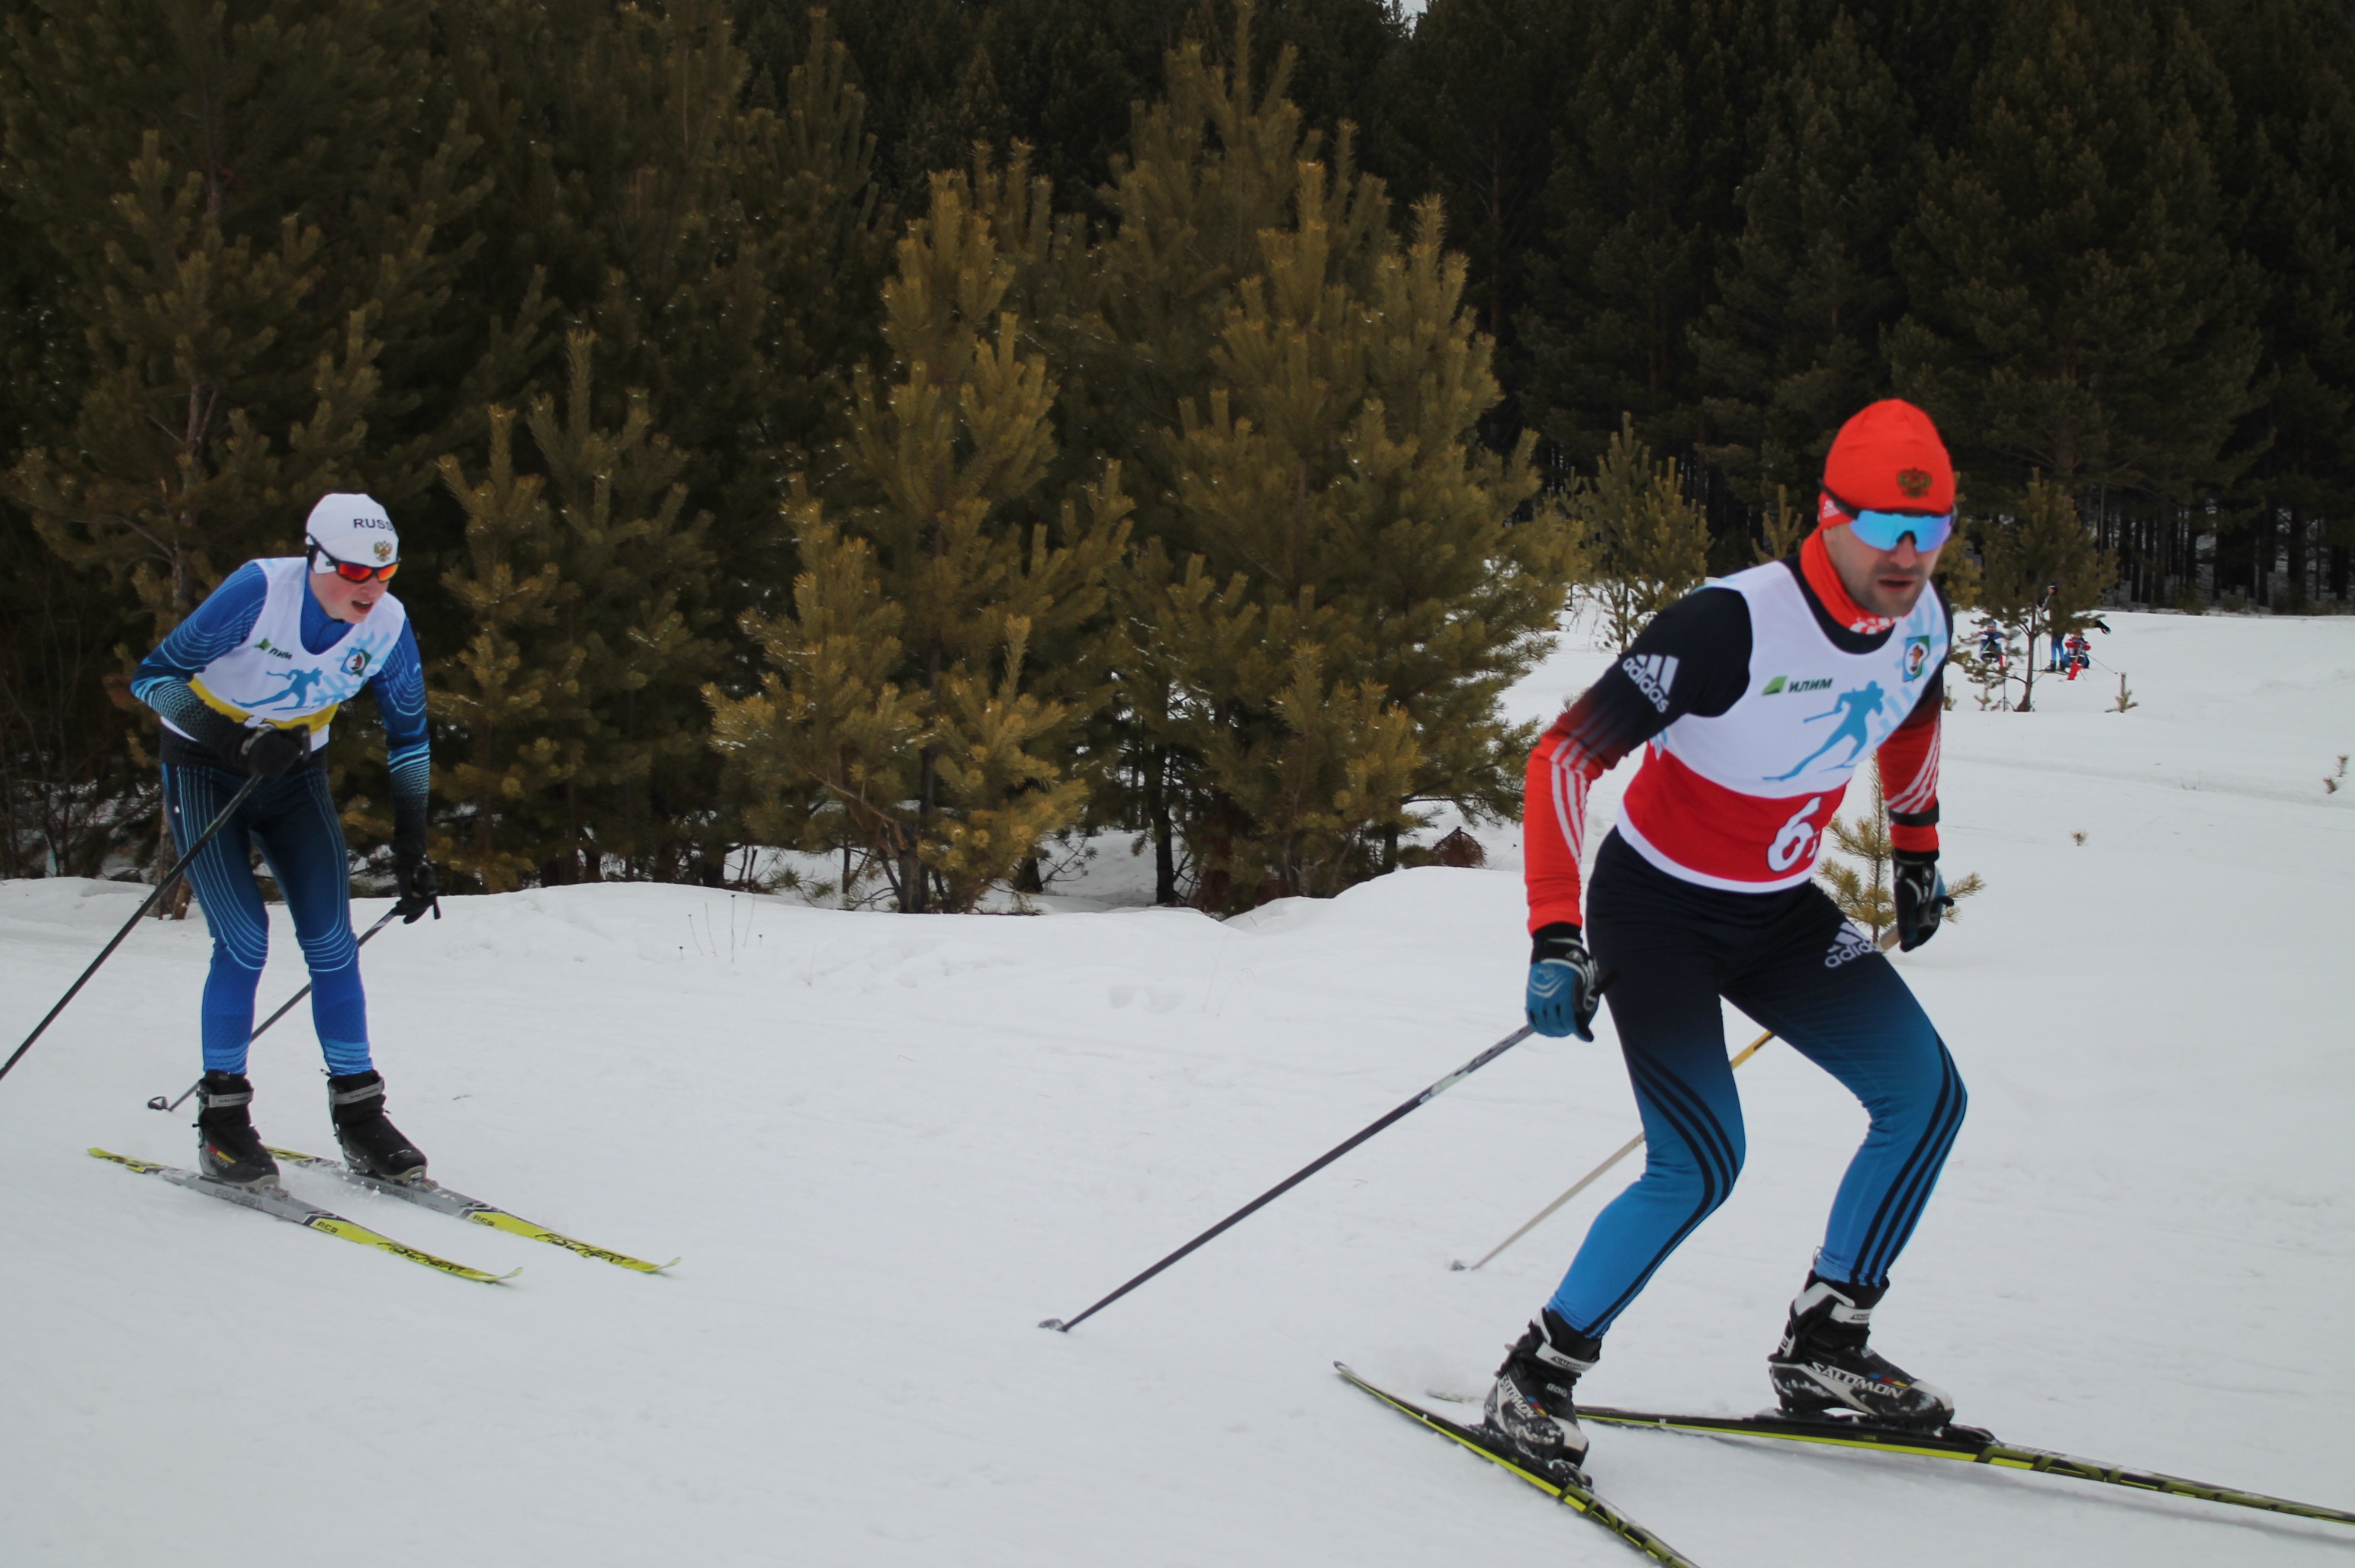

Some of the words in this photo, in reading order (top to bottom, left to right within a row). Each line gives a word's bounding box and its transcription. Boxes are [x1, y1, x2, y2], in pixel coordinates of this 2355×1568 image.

[1622, 657, 1669, 713] adidas
[1788, 677, 1833, 692] ИЛИМ
[1807, 1361, 1904, 1399] SALOMON
